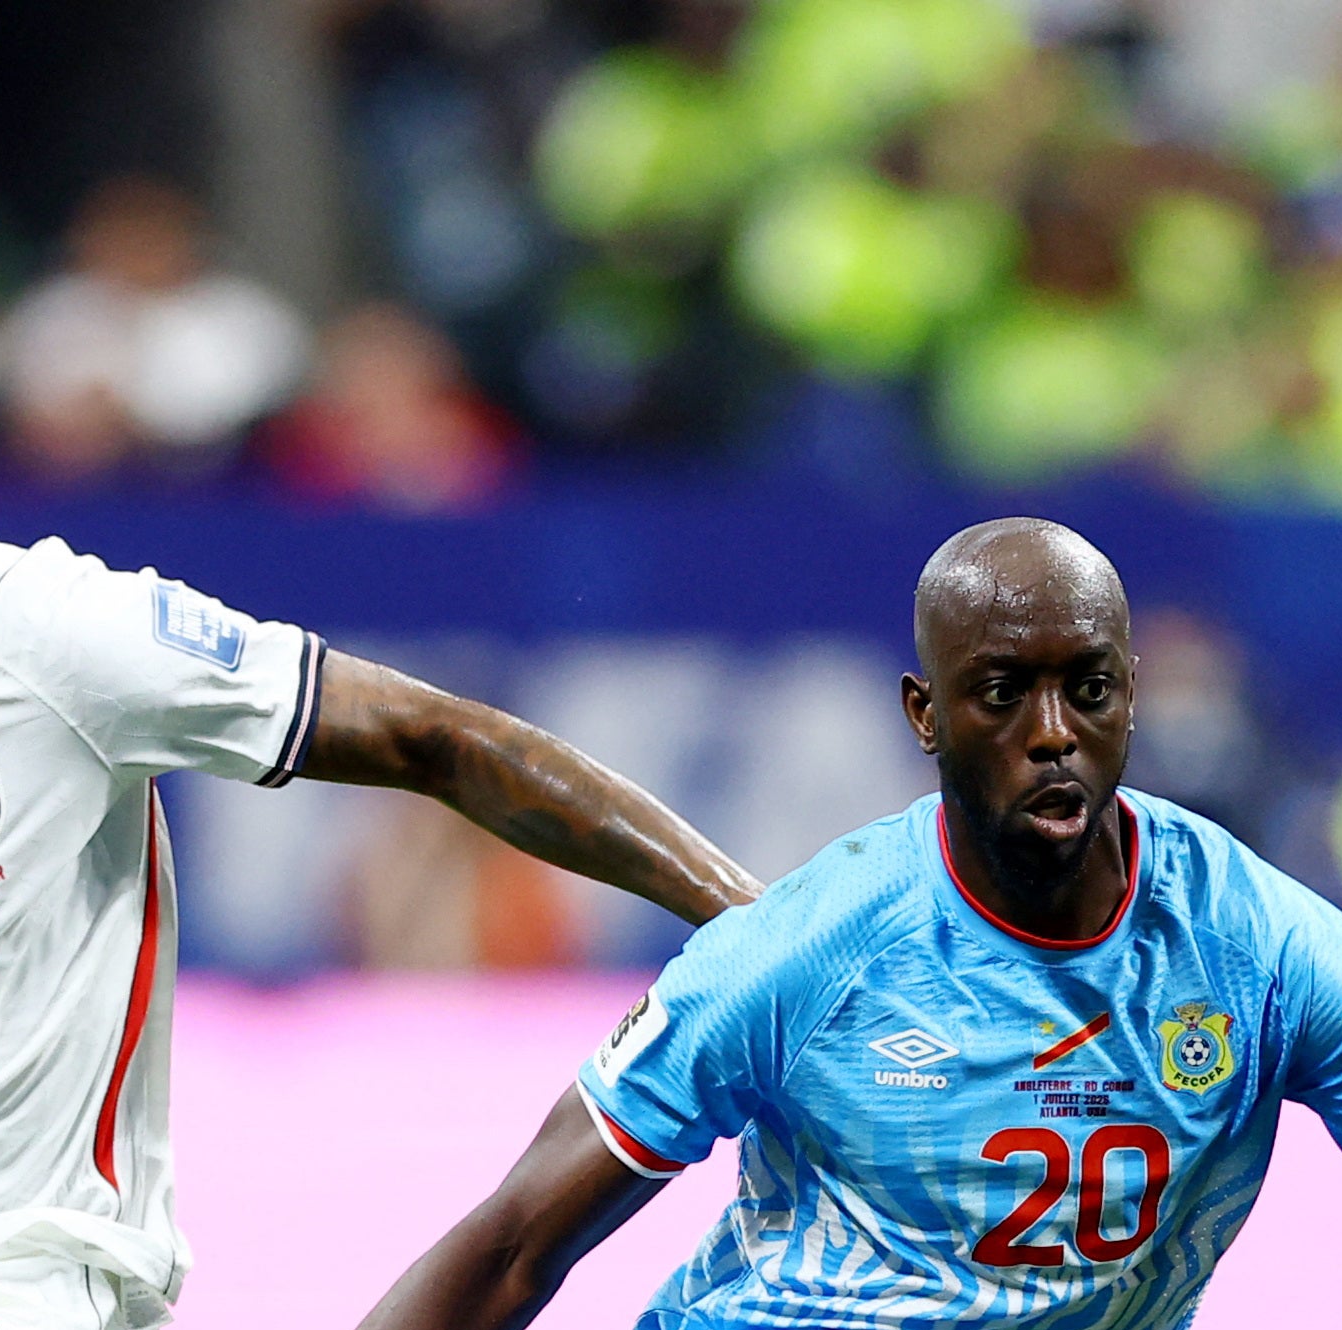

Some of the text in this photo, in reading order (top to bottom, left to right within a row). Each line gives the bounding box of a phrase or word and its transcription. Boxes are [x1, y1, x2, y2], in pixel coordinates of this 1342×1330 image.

[874, 1070, 948, 1089] umbro
[1173, 1066, 1225, 1087] FECOFA
[1084, 1081, 1098, 1092] RD
[1041, 1093, 1081, 1105] JUILLET
[971, 1123, 1172, 1268] 20
